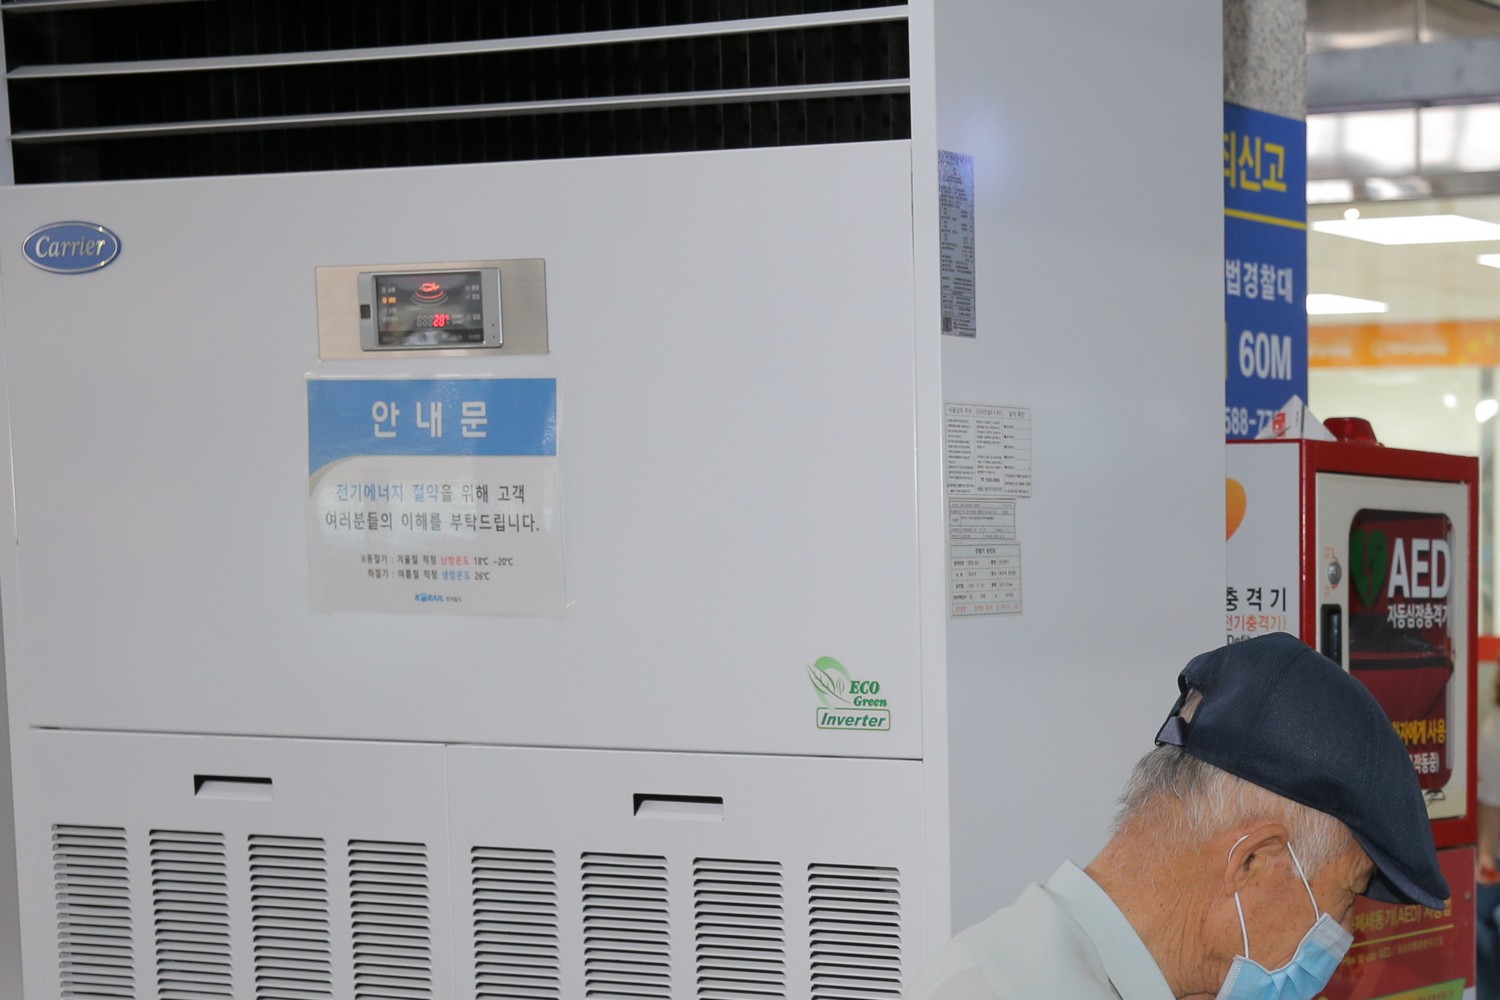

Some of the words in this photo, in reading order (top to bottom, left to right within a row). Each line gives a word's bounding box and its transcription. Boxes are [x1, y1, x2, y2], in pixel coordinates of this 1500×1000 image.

[35, 235, 106, 258] Carrier
[1225, 258, 1293, 304] 법경찰대
[1239, 329, 1292, 381] 60M
[336, 483, 403, 502] 전기에너지
[412, 483, 452, 503] 절약을
[462, 484, 489, 503] 위해
[498, 484, 525, 503] 고객
[325, 511, 393, 531] 여러분들의
[401, 511, 442, 531] 이해를
[451, 513, 540, 532] 부탁드립니다.
[441, 556, 470, 566] 난방온도
[1387, 537, 1450, 599] AED
[368, 569, 389, 579] 하절기
[398, 569, 419, 580] 여름철
[442, 570, 470, 580] 냉방온도
[849, 680, 880, 694] ECO
[853, 695, 888, 707] Green
[821, 712, 887, 727] Inverter
[1427, 718, 1446, 744] 사용
